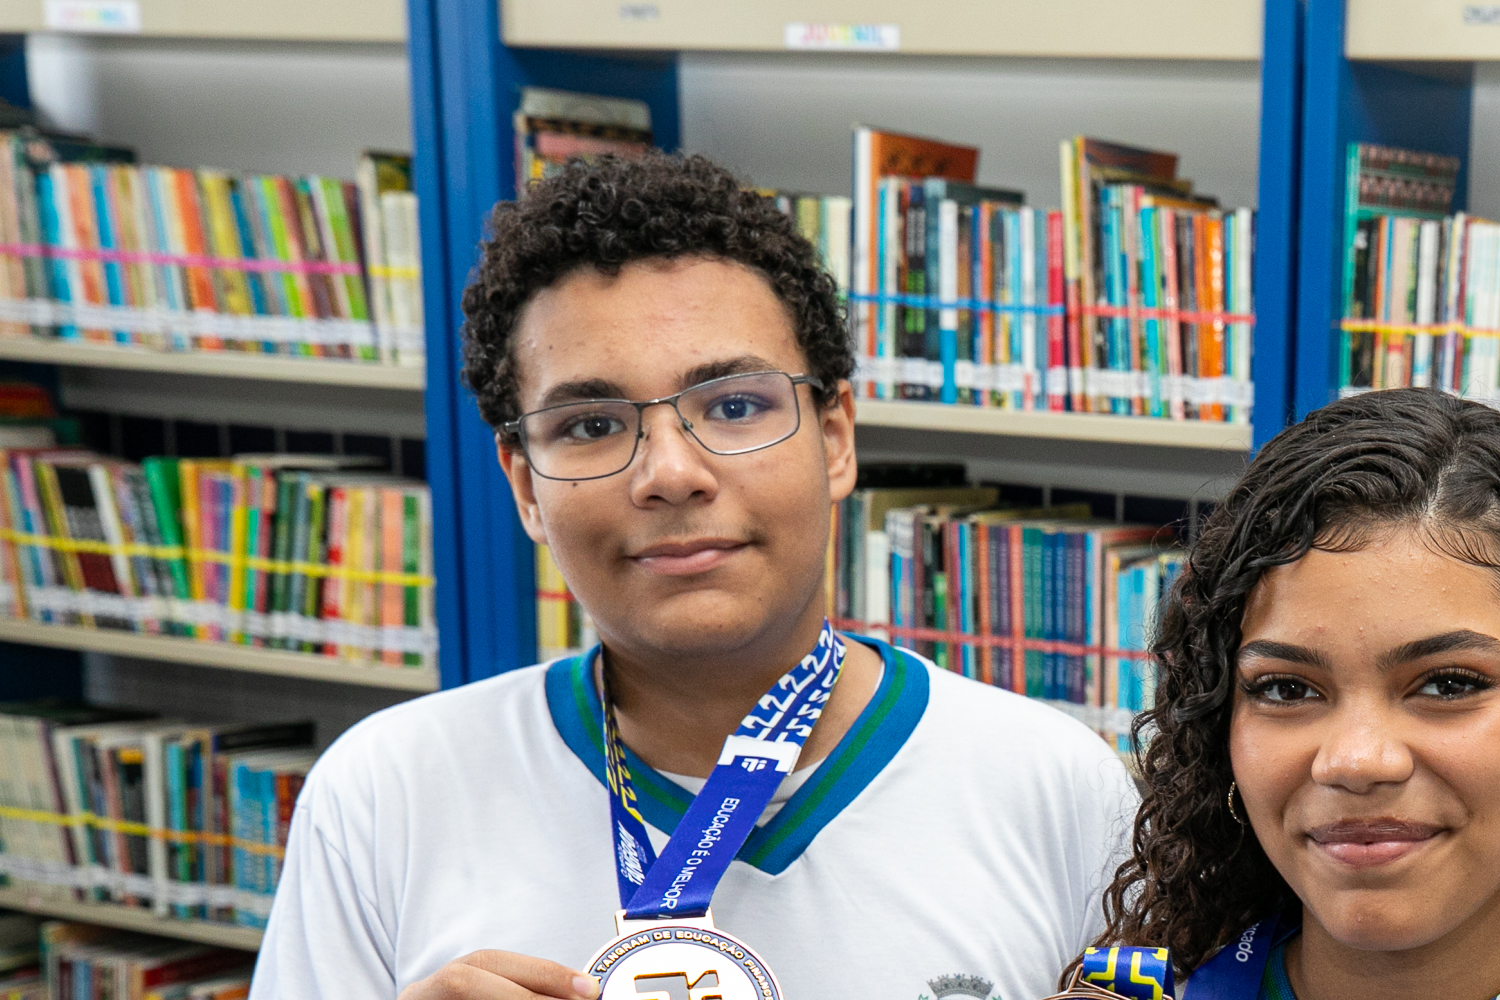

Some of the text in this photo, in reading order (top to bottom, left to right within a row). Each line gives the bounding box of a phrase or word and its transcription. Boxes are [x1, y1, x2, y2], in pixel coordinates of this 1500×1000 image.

[701, 797, 741, 849] EDUCAÇÃO
[691, 849, 711, 857] É
[660, 866, 698, 910] MELHOR
[596, 934, 651, 973] TANGRAM
[653, 930, 672, 941] DE
[675, 930, 745, 960] EDUCAÇÃO
